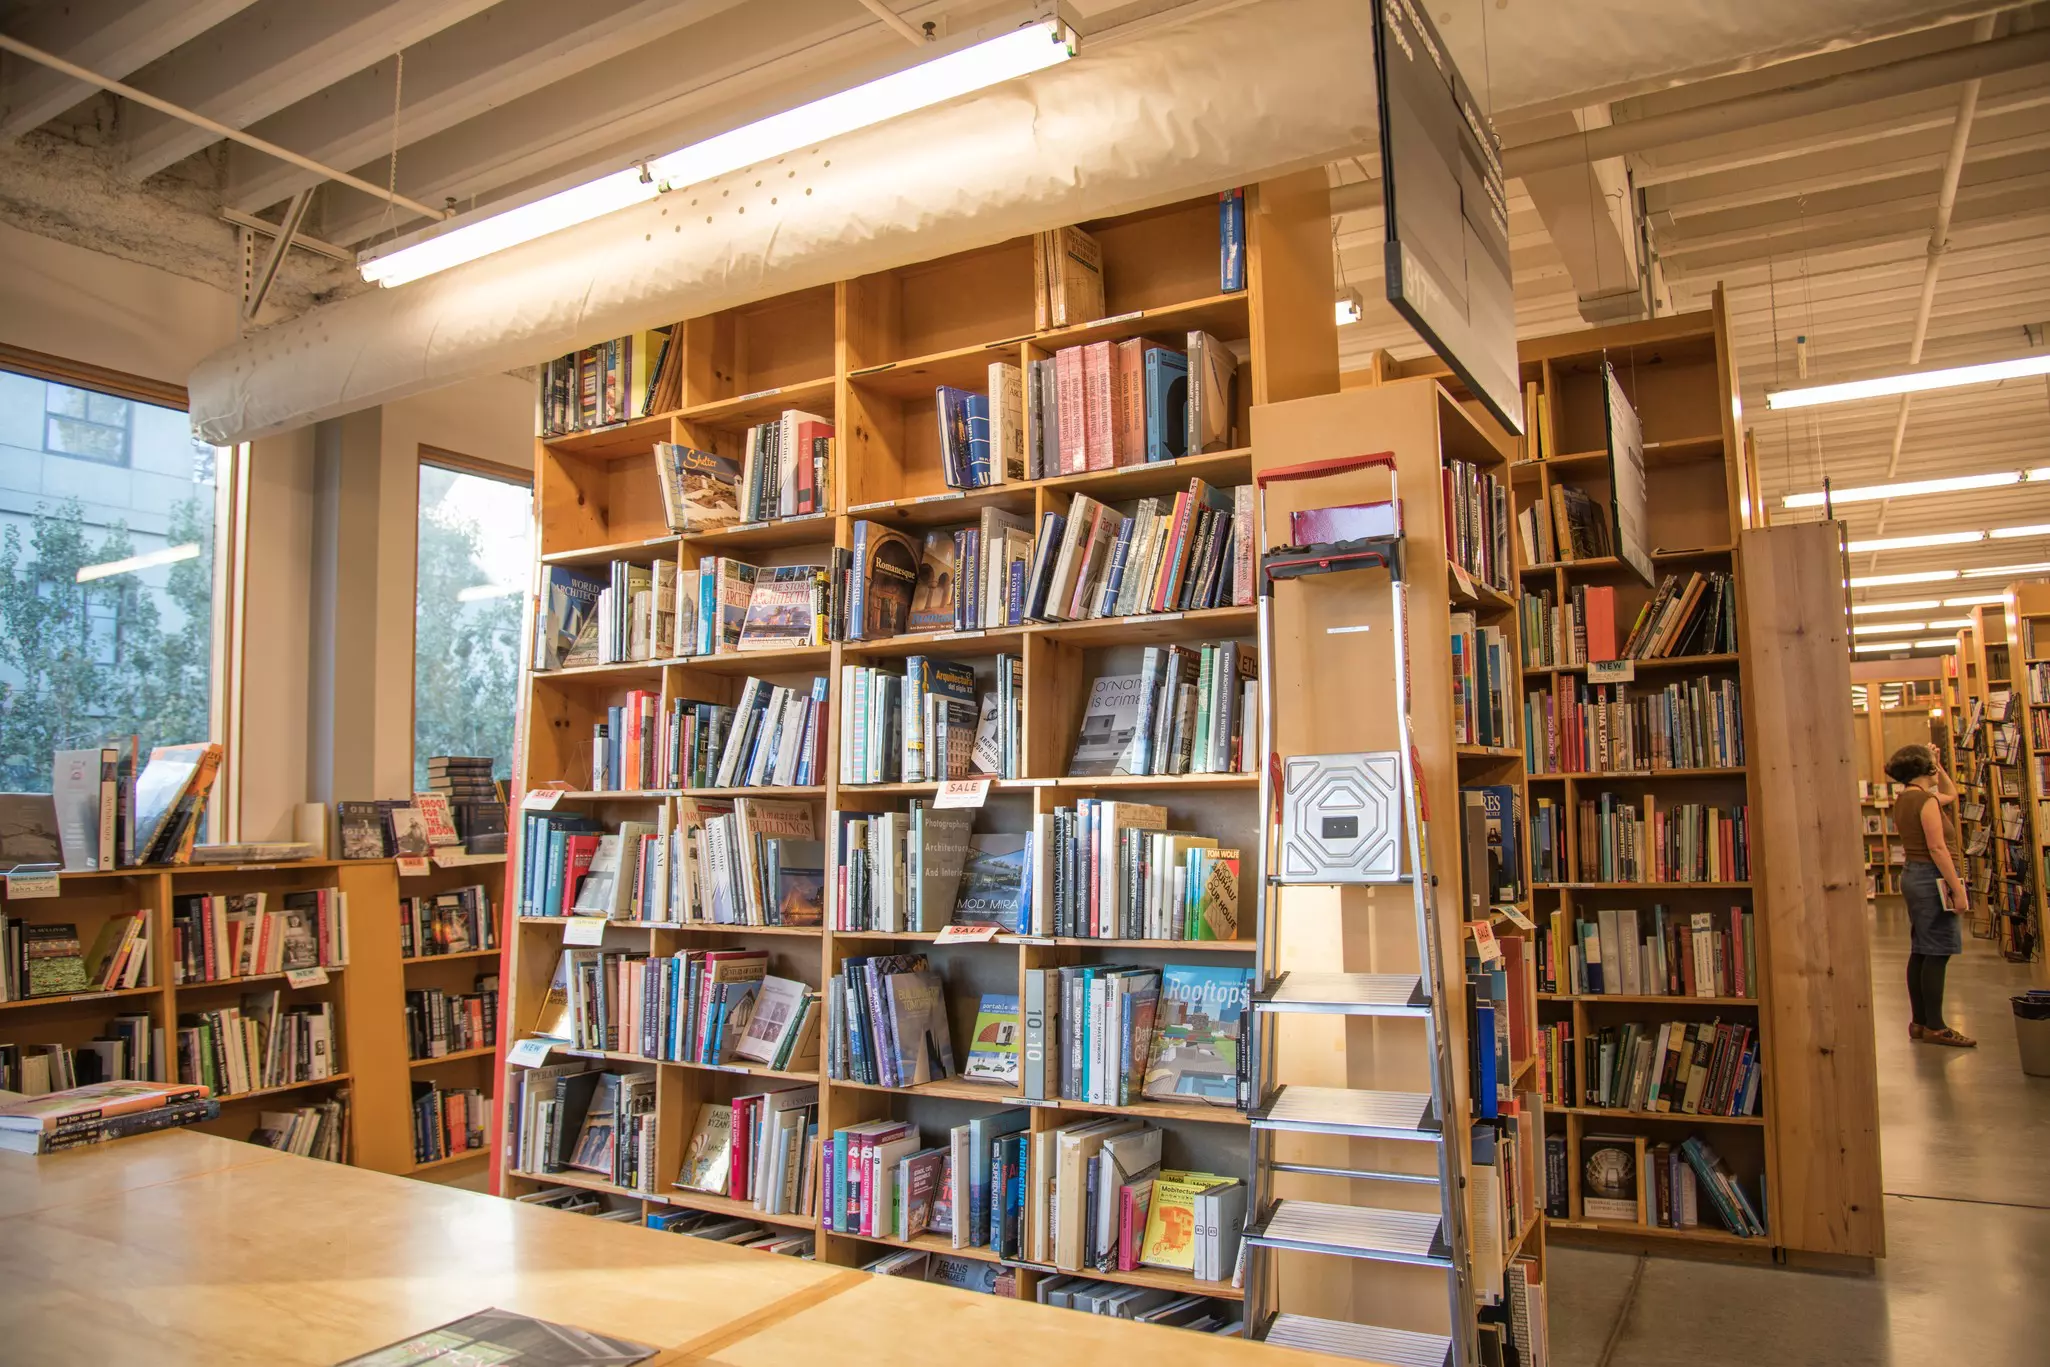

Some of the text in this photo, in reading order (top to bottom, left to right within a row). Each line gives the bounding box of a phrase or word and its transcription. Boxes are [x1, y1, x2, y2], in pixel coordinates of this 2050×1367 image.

[683, 449, 717, 469] Shelter
[1191, 512, 1209, 572] Modern Architecture
[1203, 512, 1220, 571] Modern Architecture
[854, 543, 866, 607] Romanesque
[875, 556, 916, 580] Romanesque
[571, 578, 600, 594] WORLD
[1242, 654, 1258, 674] ETH
[1599, 662, 1622, 670] NEW
[935, 669, 974, 688] Arquitectura
[739, 685, 757, 730] Architecture
[1091, 694, 1102, 708] is
[1598, 694, 1607, 763] CHINA LOFTS
[535, 790, 557, 799] SALE
[949, 782, 978, 794] SALE
[419, 799, 447, 809] SHOOT
[422, 808, 440, 817] FOR
[759, 809, 800, 821] Amazing
[425, 817, 441, 826] THE
[749, 819, 811, 835] BUILDINGS
[925, 818, 969, 831] Photographing
[428, 826, 454, 836] MOON
[1055, 827, 1065, 872] Nouveau
[925, 868, 938, 876] And
[957, 899, 987, 910] MOD
[1055, 875, 1065, 933] Architecture
[953, 926, 985, 935] SALE
[296, 969, 314, 977] NEW
[1167, 978, 1249, 1005] Rooftops
[1027, 1009, 1043, 1061] 10 10
[522, 1044, 543, 1053] NEW
[849, 1146, 859, 1158] 4
[1018, 1137, 1028, 1206] Architecture
[939, 1261, 969, 1274] TRANS
[935, 1269, 966, 1283] FORMER
